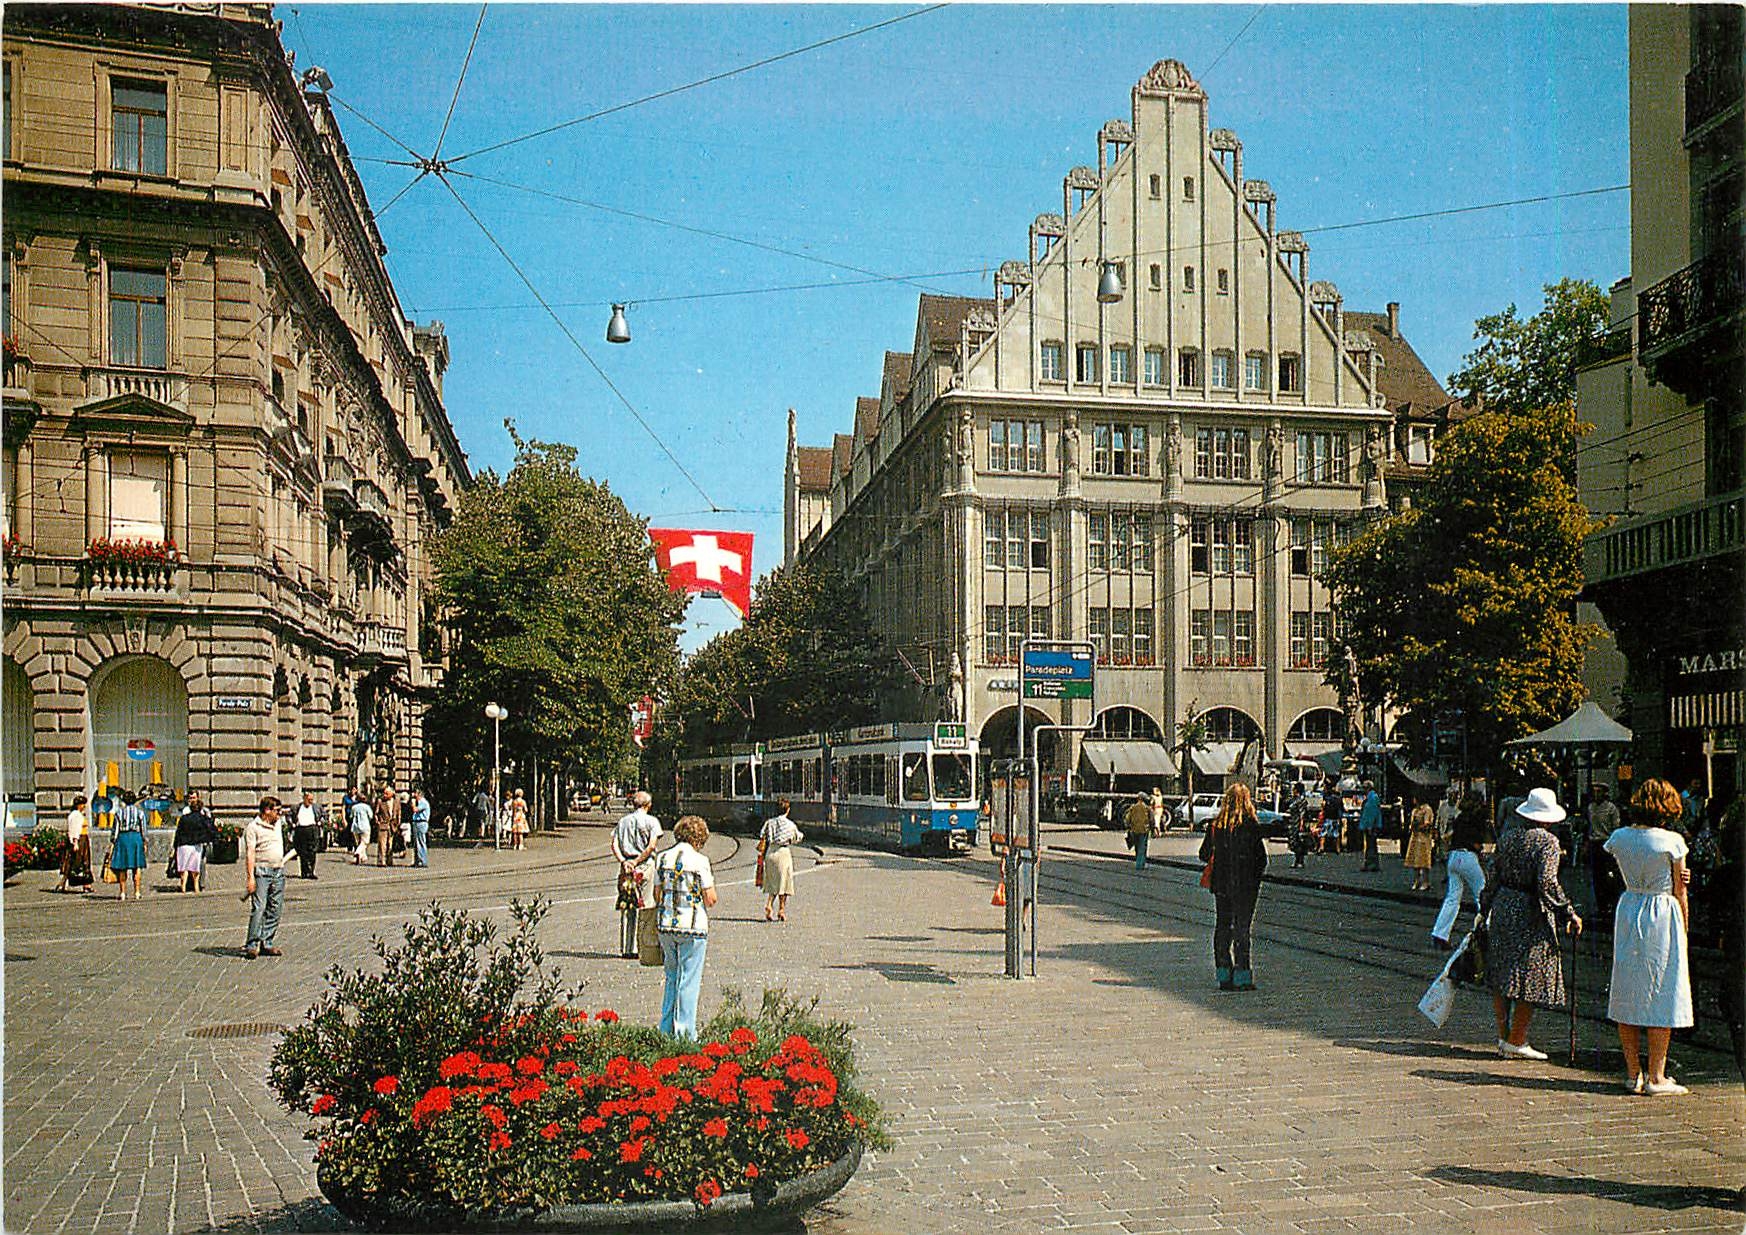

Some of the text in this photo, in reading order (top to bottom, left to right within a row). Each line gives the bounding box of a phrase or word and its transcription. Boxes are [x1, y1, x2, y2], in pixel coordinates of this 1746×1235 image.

[1025, 665, 1073, 675] Paradeplatz
[1032, 684, 1043, 696] 11
[946, 726, 957, 737] 11
